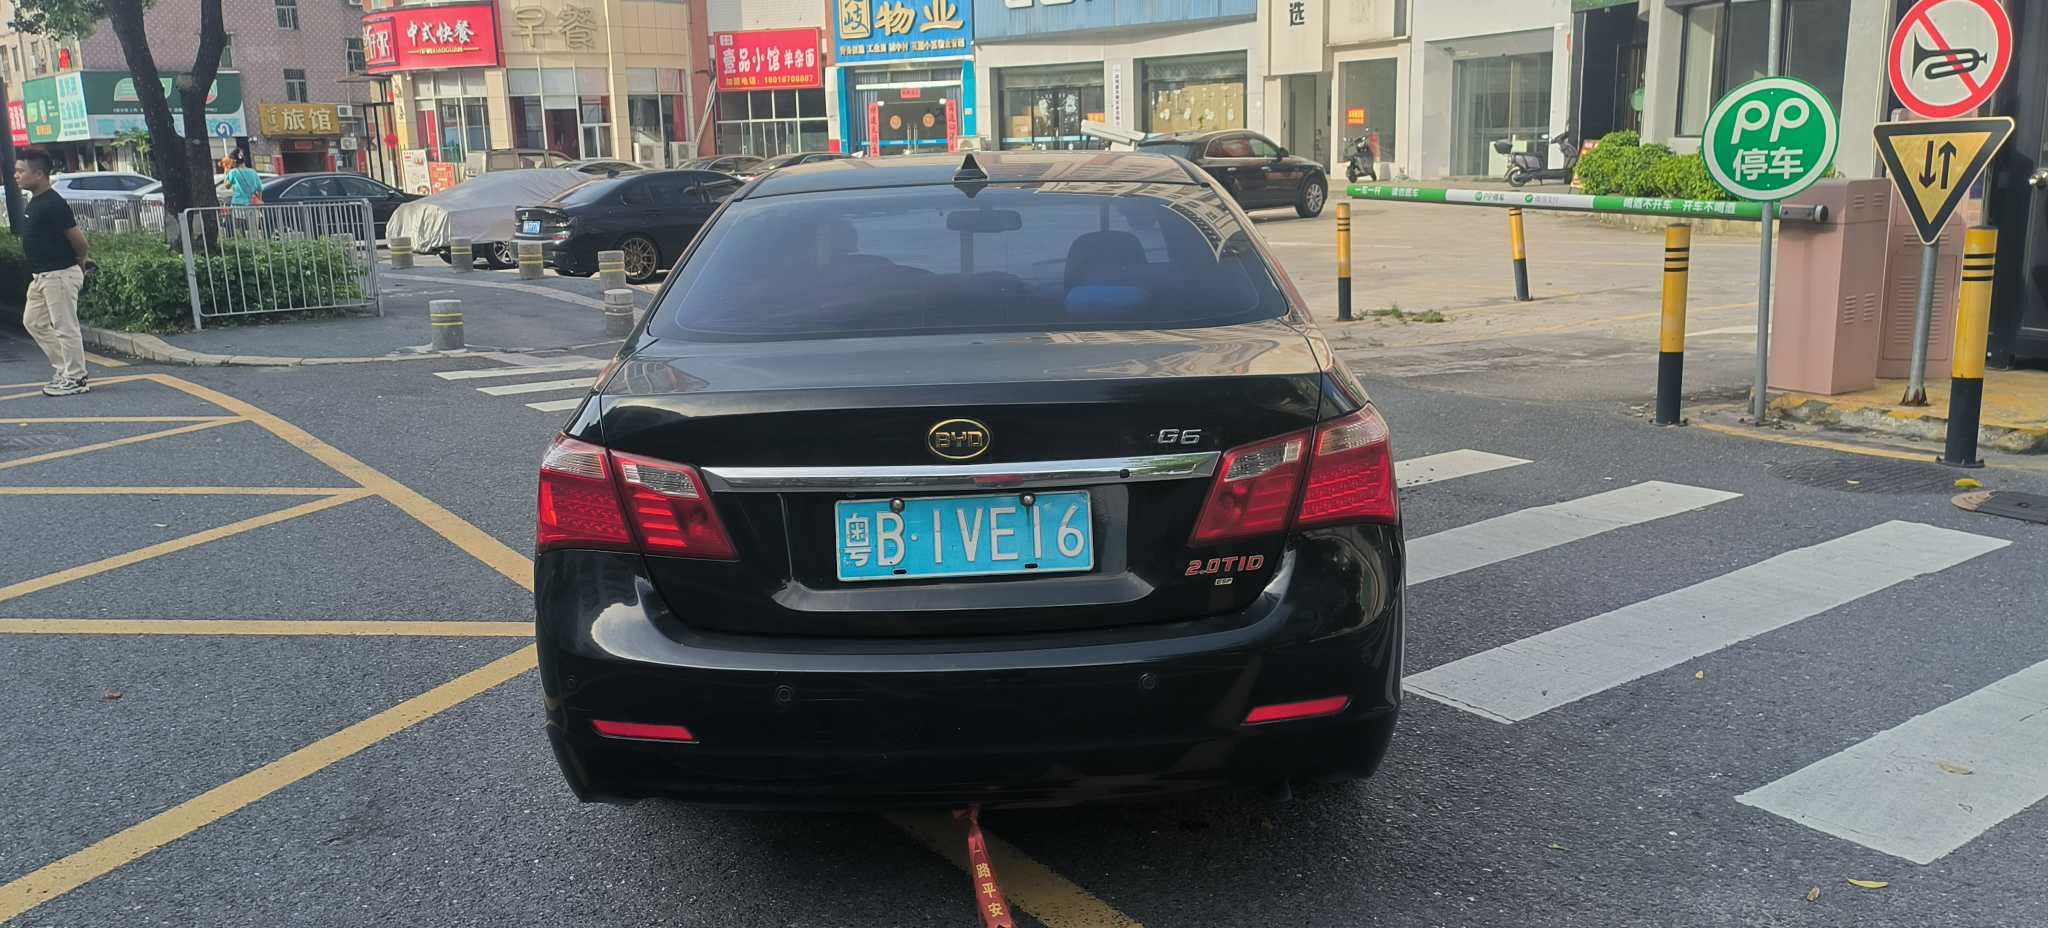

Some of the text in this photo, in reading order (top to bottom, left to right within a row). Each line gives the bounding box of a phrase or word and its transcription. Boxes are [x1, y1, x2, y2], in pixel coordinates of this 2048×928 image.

[407, 19, 475, 47] 中式快餐
[511, 3, 598, 48] 早餐
[722, 46, 780, 74] 壹品小馆
[281, 107, 332, 130] 旅馆
[1730, 98, 1810, 145] PP
[1732, 146, 1804, 182] 停车
[934, 430, 983, 449] BYD
[1157, 427, 1202, 445] G6
[973, 848, 1005, 918] 一路平安
